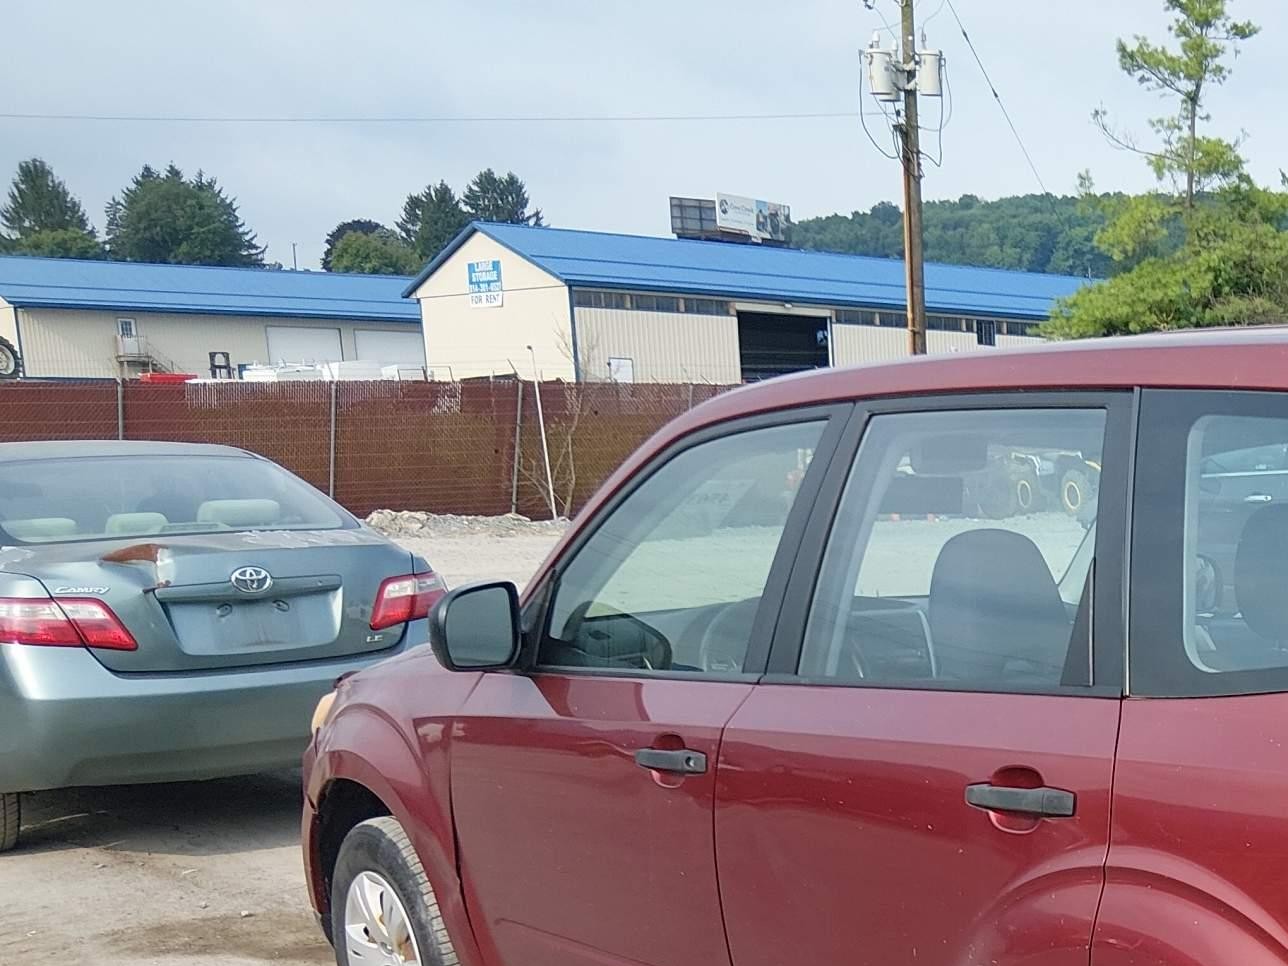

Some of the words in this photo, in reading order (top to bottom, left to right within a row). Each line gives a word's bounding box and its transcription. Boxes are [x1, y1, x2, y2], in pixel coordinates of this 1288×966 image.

[471, 270, 498, 282] STORAGE
[471, 295, 482, 305] FOR
[486, 293, 499, 304] RENT
